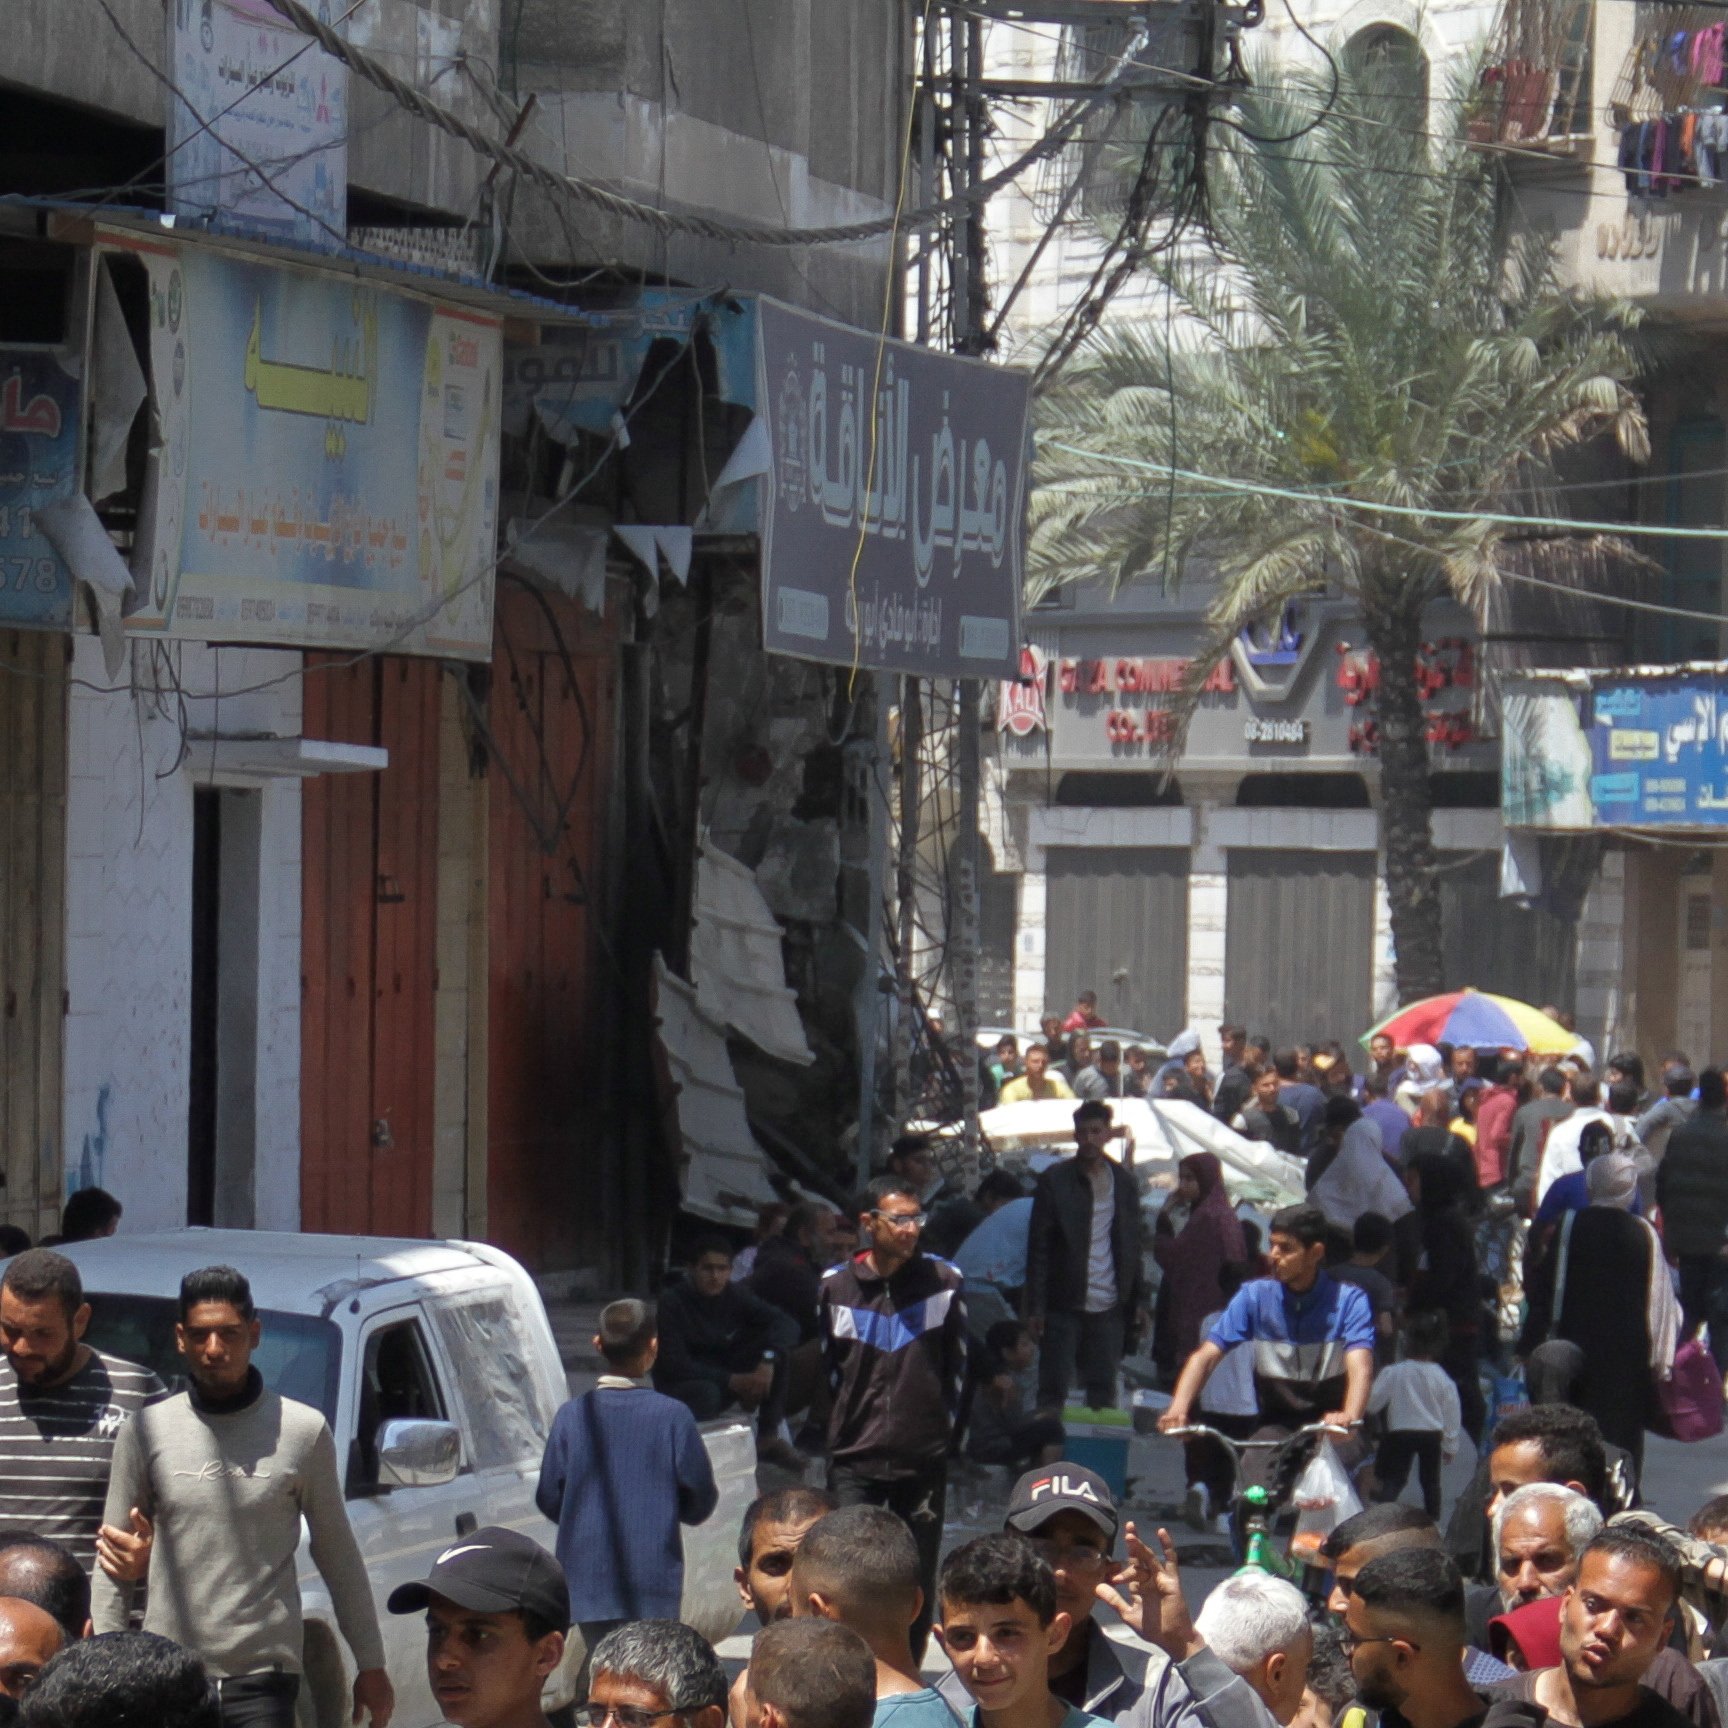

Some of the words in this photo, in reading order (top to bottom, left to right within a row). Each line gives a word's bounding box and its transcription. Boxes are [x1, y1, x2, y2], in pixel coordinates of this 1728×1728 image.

[808, 341, 909, 541] الأناقة
[913, 390, 1007, 588] معرض
[1031, 1475, 1099, 1502] FILA
